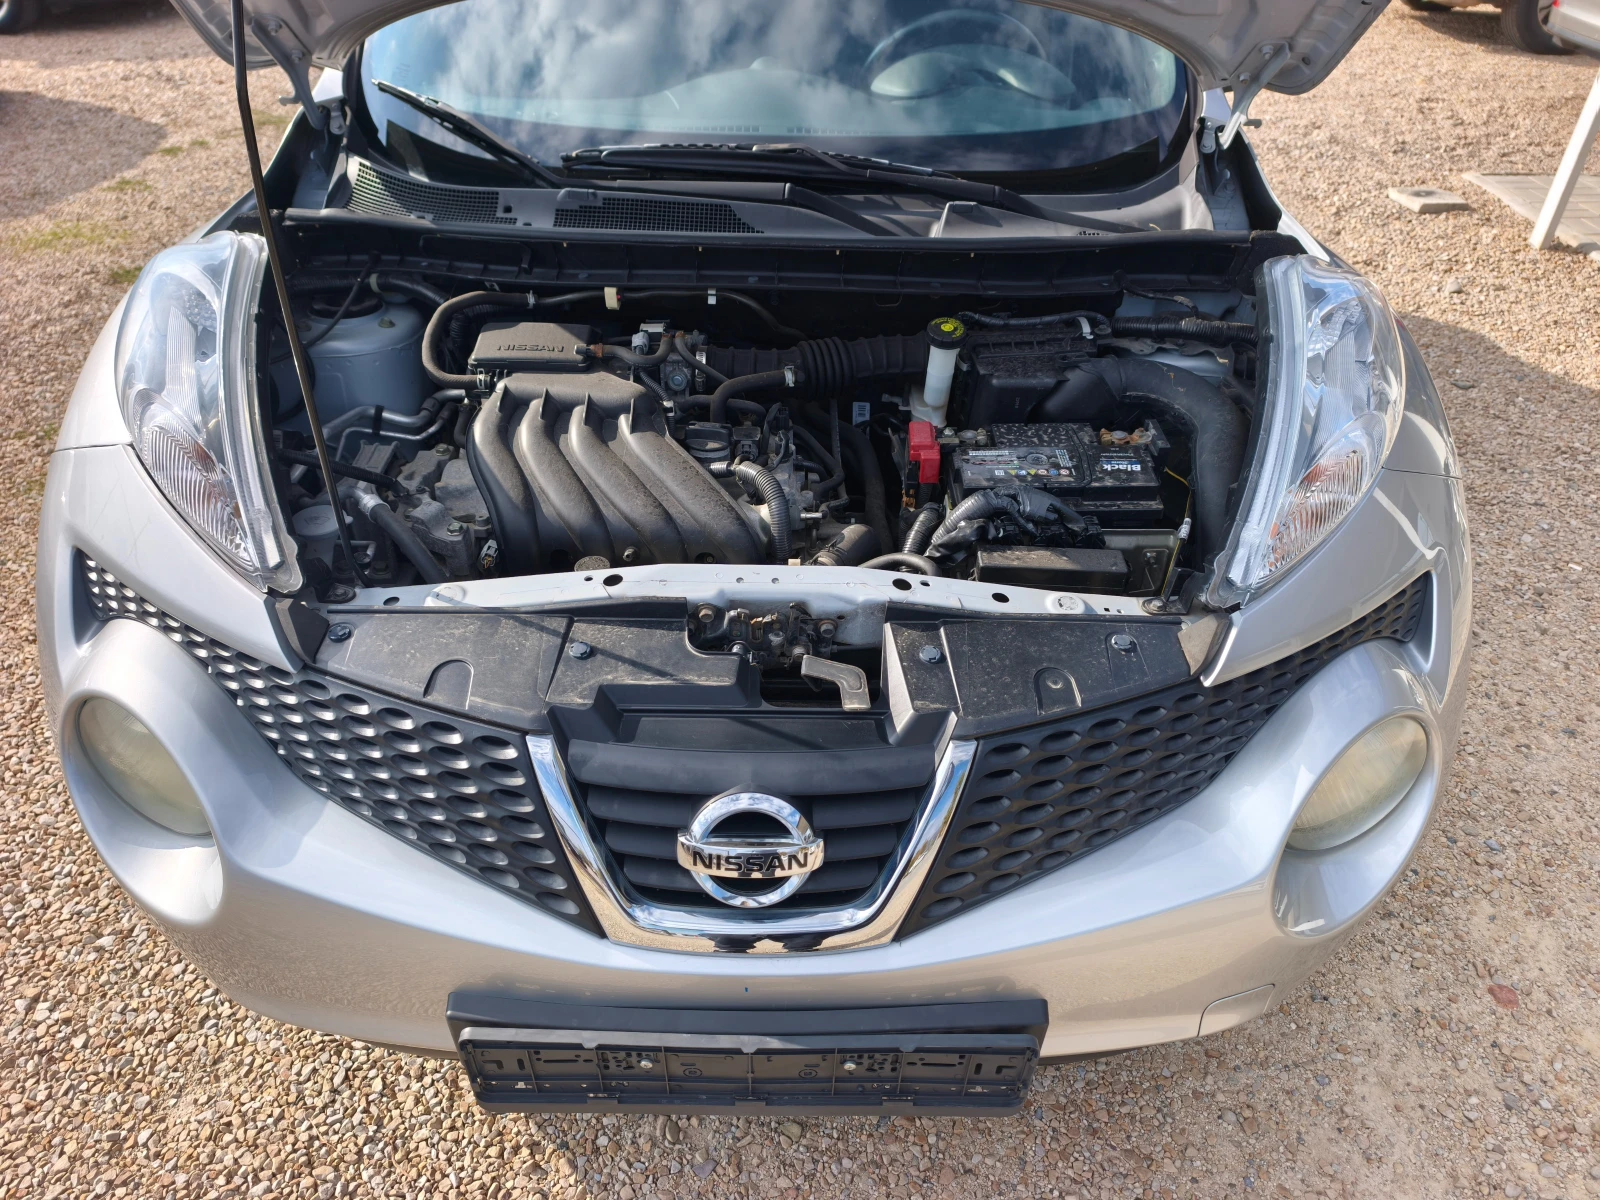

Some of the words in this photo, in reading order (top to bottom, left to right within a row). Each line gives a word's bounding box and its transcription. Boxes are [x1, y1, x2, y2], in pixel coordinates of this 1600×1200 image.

[497, 344, 565, 353] NISSAN
[1102, 463, 1141, 472] Black
[692, 850, 808, 873] NISSAN
